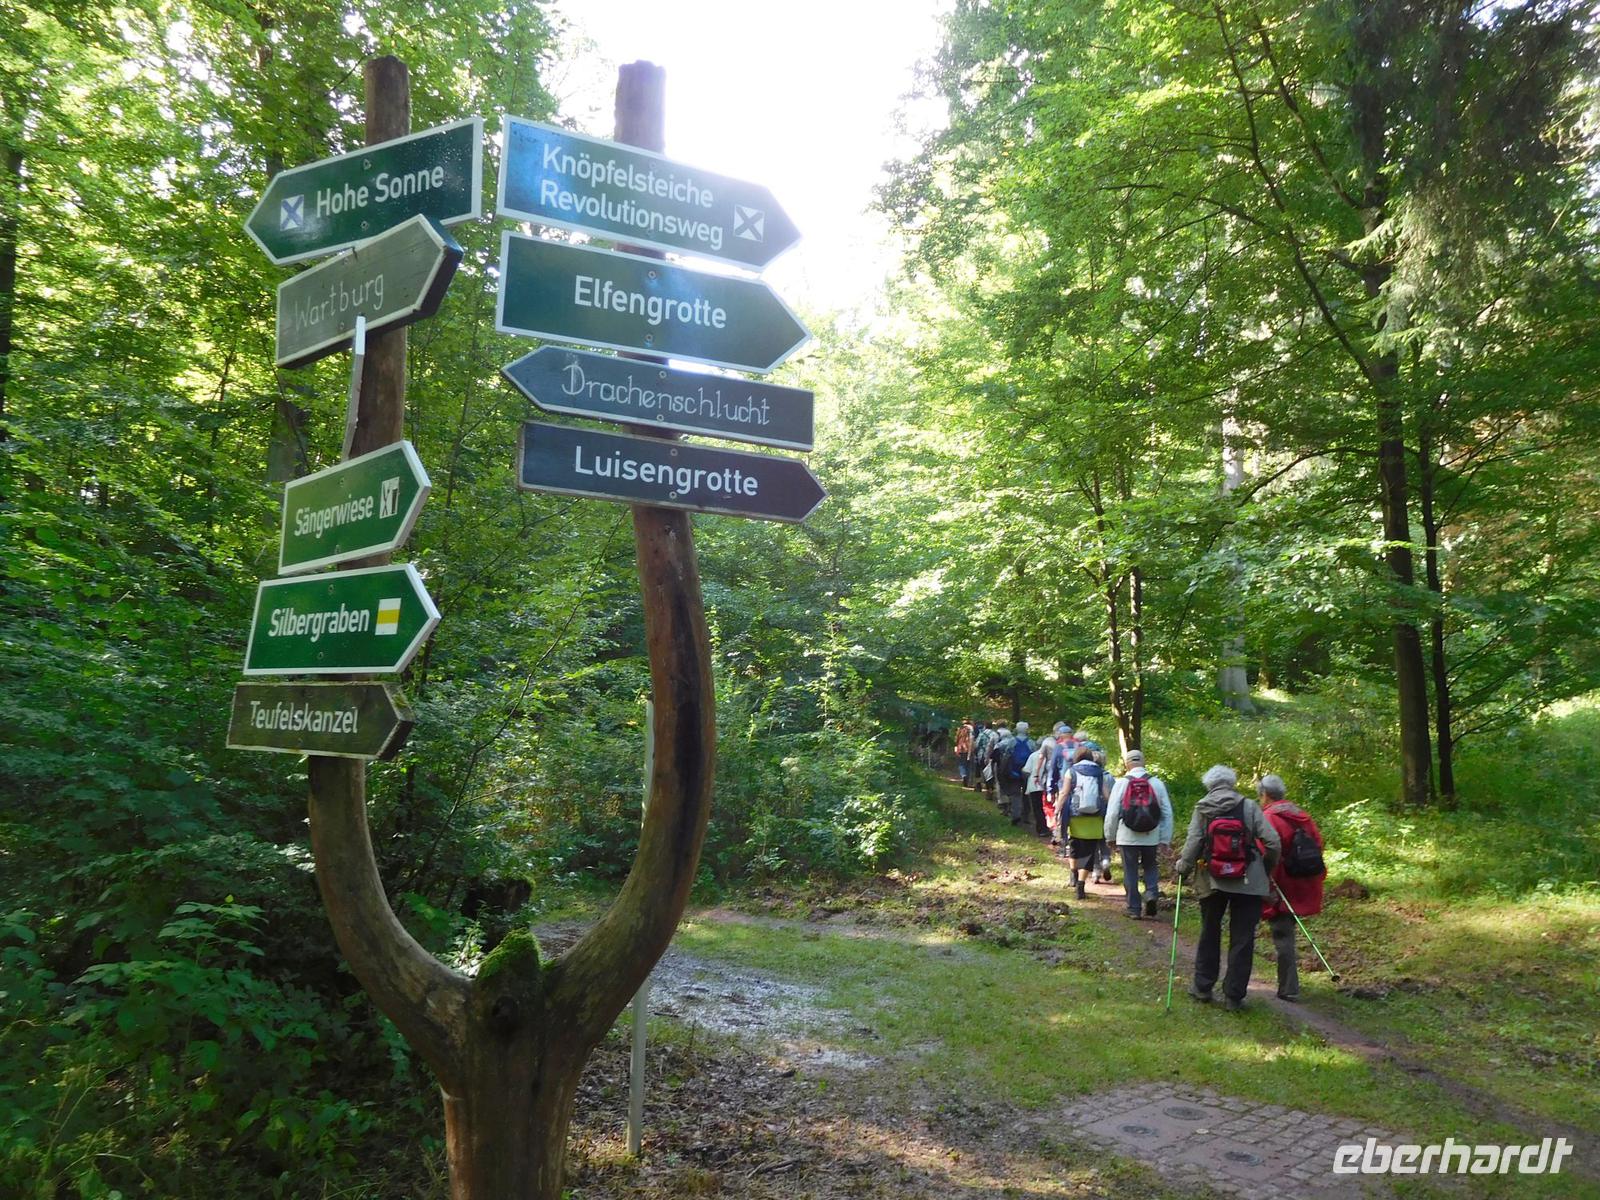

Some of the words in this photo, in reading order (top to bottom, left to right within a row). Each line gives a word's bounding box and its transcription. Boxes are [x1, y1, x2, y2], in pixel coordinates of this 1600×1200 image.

[316, 183, 369, 218] Hohe
[375, 165, 444, 203] Sonne
[542, 143, 714, 208] Knöpfelsteiche
[541, 180, 723, 249] Revolutionsweg
[294, 274, 384, 331] Wartburg
[574, 275, 727, 329] Elfengrotte
[561, 362, 770, 426] Drachenschlucht
[575, 445, 758, 497] Luisengrotte
[294, 493, 374, 539] Sängerwiese
[268, 603, 370, 642] Silbergraben
[250, 701, 358, 734] Teufelskanzel
